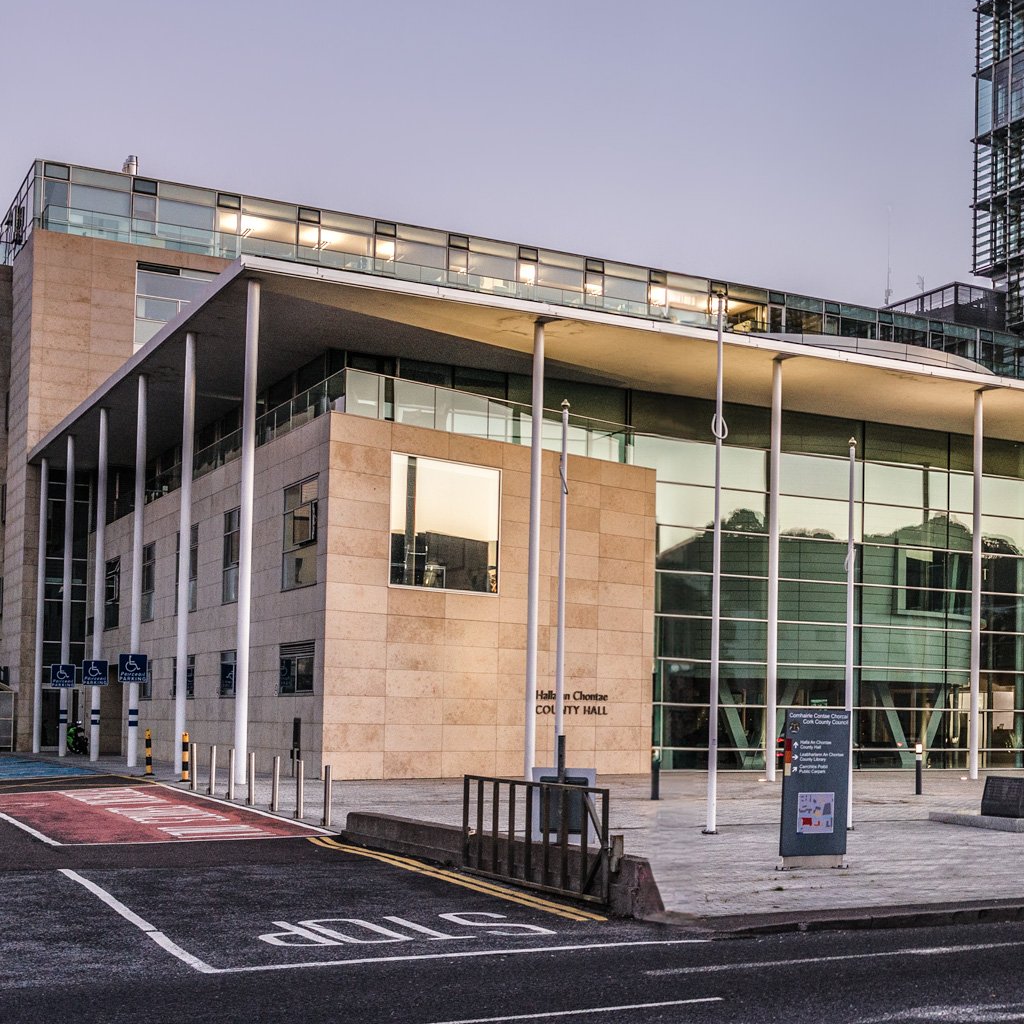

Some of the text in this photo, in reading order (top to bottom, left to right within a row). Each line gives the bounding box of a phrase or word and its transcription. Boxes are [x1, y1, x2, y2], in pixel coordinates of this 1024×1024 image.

[573, 691, 608, 701] Chontae
[584, 706, 608, 715] HALL
[258, 912, 557, 946] STOP
